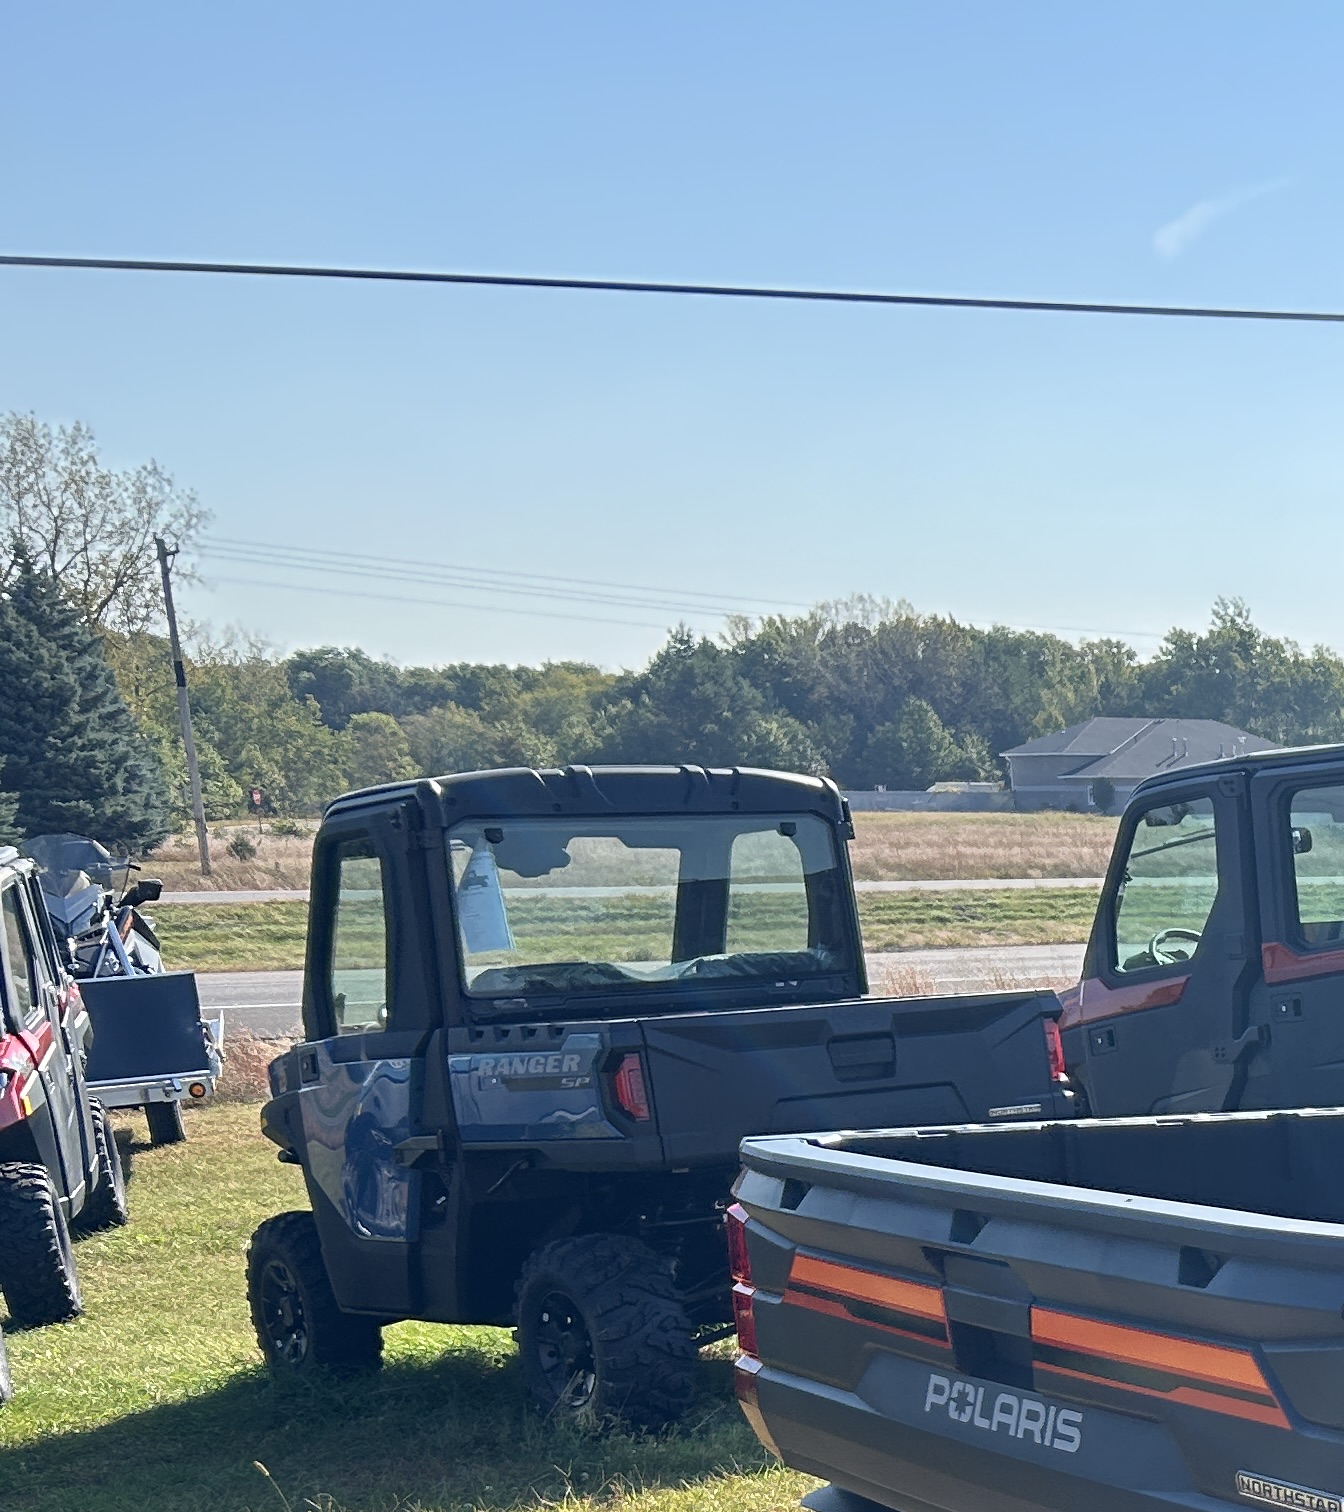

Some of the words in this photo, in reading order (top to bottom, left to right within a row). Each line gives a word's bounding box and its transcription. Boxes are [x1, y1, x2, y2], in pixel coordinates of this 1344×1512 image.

[477, 1054, 581, 1077] RANGER
[560, 1077, 591, 1089] SP
[924, 1374, 1084, 1453] POLARIS
